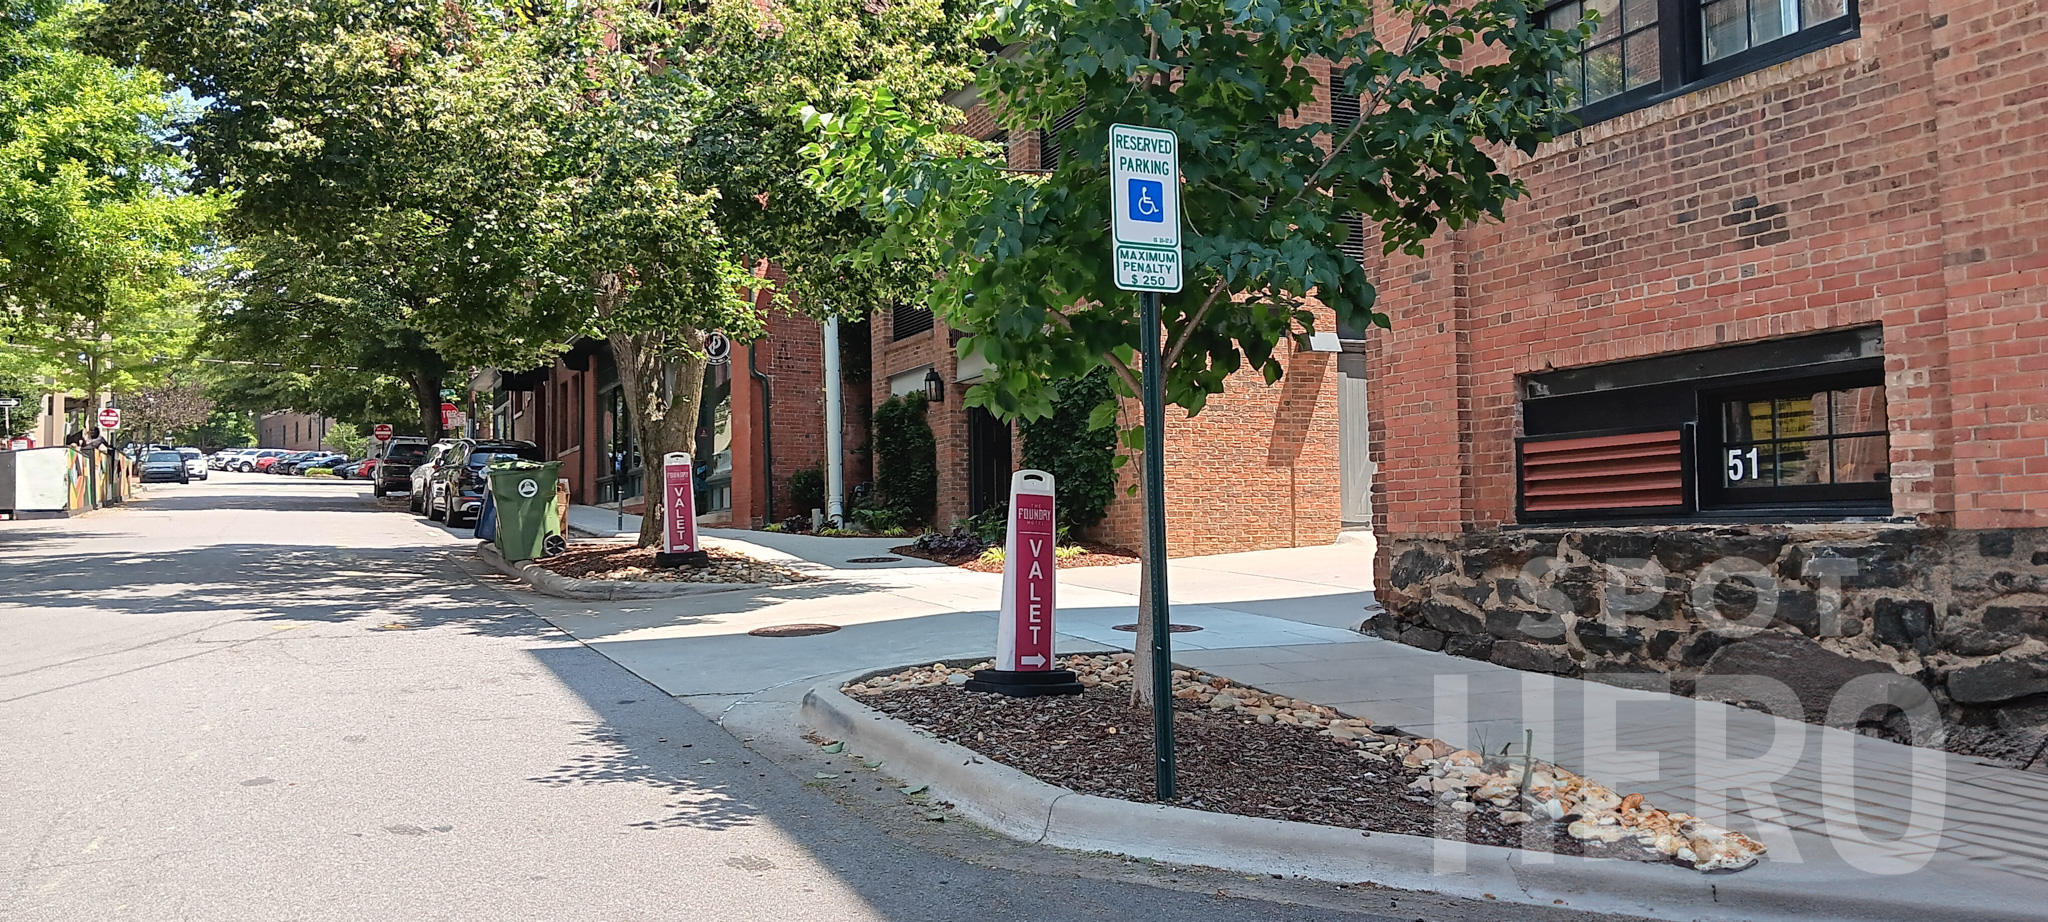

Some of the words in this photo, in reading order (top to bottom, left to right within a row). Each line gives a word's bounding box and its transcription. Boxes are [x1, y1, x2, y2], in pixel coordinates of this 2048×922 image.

[1116, 133, 1172, 155] RESERVED
[1120, 156, 1170, 176] PARKING
[1120, 249, 1175, 263] MAXIMUM
[1123, 261, 1172, 275] PENALTY
[1131, 273, 1138, 286] $
[1143, 275, 1166, 286] 250
[1728, 447, 1759, 481] 51
[673, 486, 686, 541] VALET
[1018, 507, 1051, 521] FOUNDRY
[1028, 538, 1044, 645] VALET
